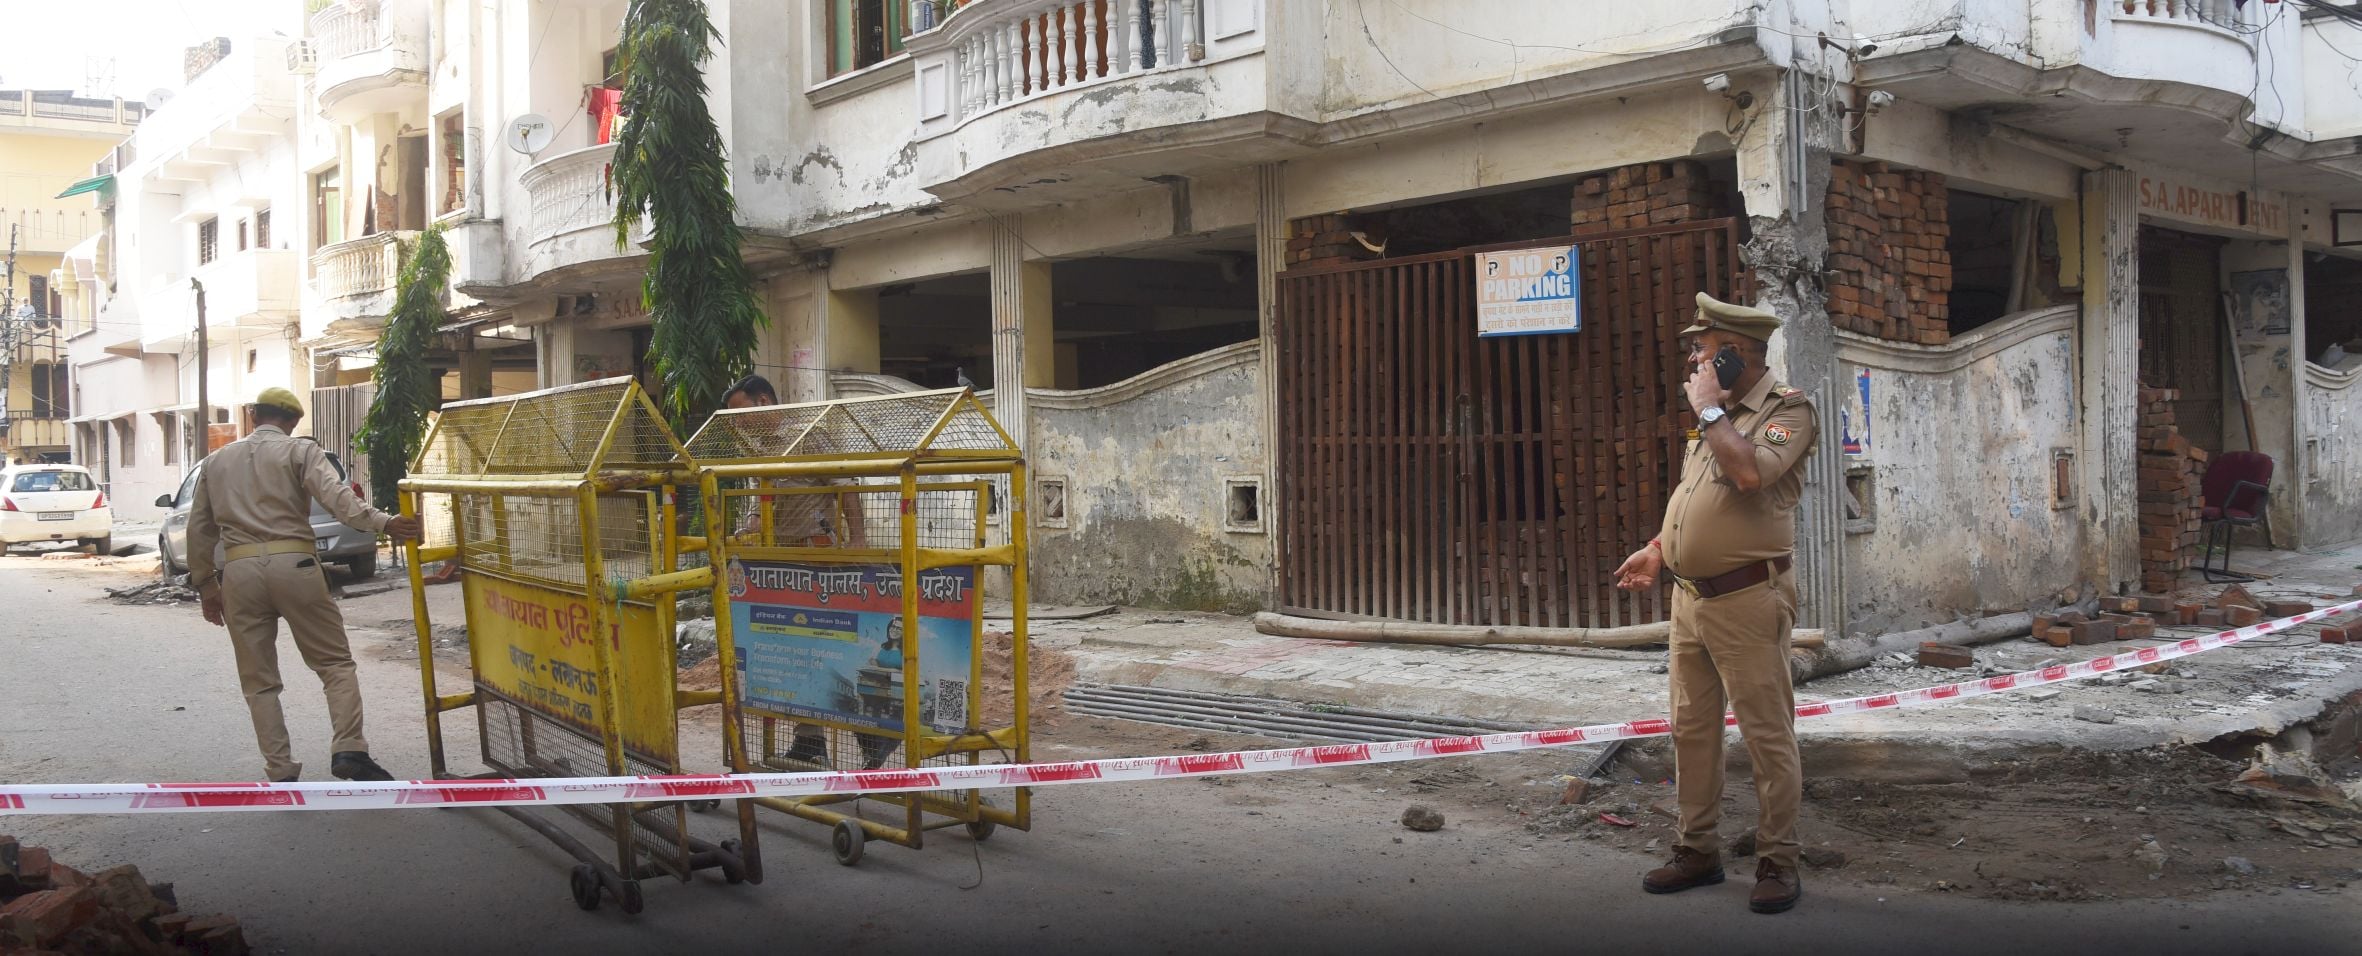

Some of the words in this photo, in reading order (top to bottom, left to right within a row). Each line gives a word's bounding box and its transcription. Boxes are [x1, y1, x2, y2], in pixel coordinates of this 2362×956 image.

[2140, 178, 2280, 230] S.A.APARTENT
[1509, 255, 1542, 276] NO
[1483, 274, 1571, 303] PARKING
[749, 566, 814, 592] यातायात
[921, 568, 965, 601] प्रदेश
[812, 617, 834, 625] Indian
[835, 618, 852, 626] Bank
[752, 700, 769, 710] FROM
[813, 710, 823, 720] TO
